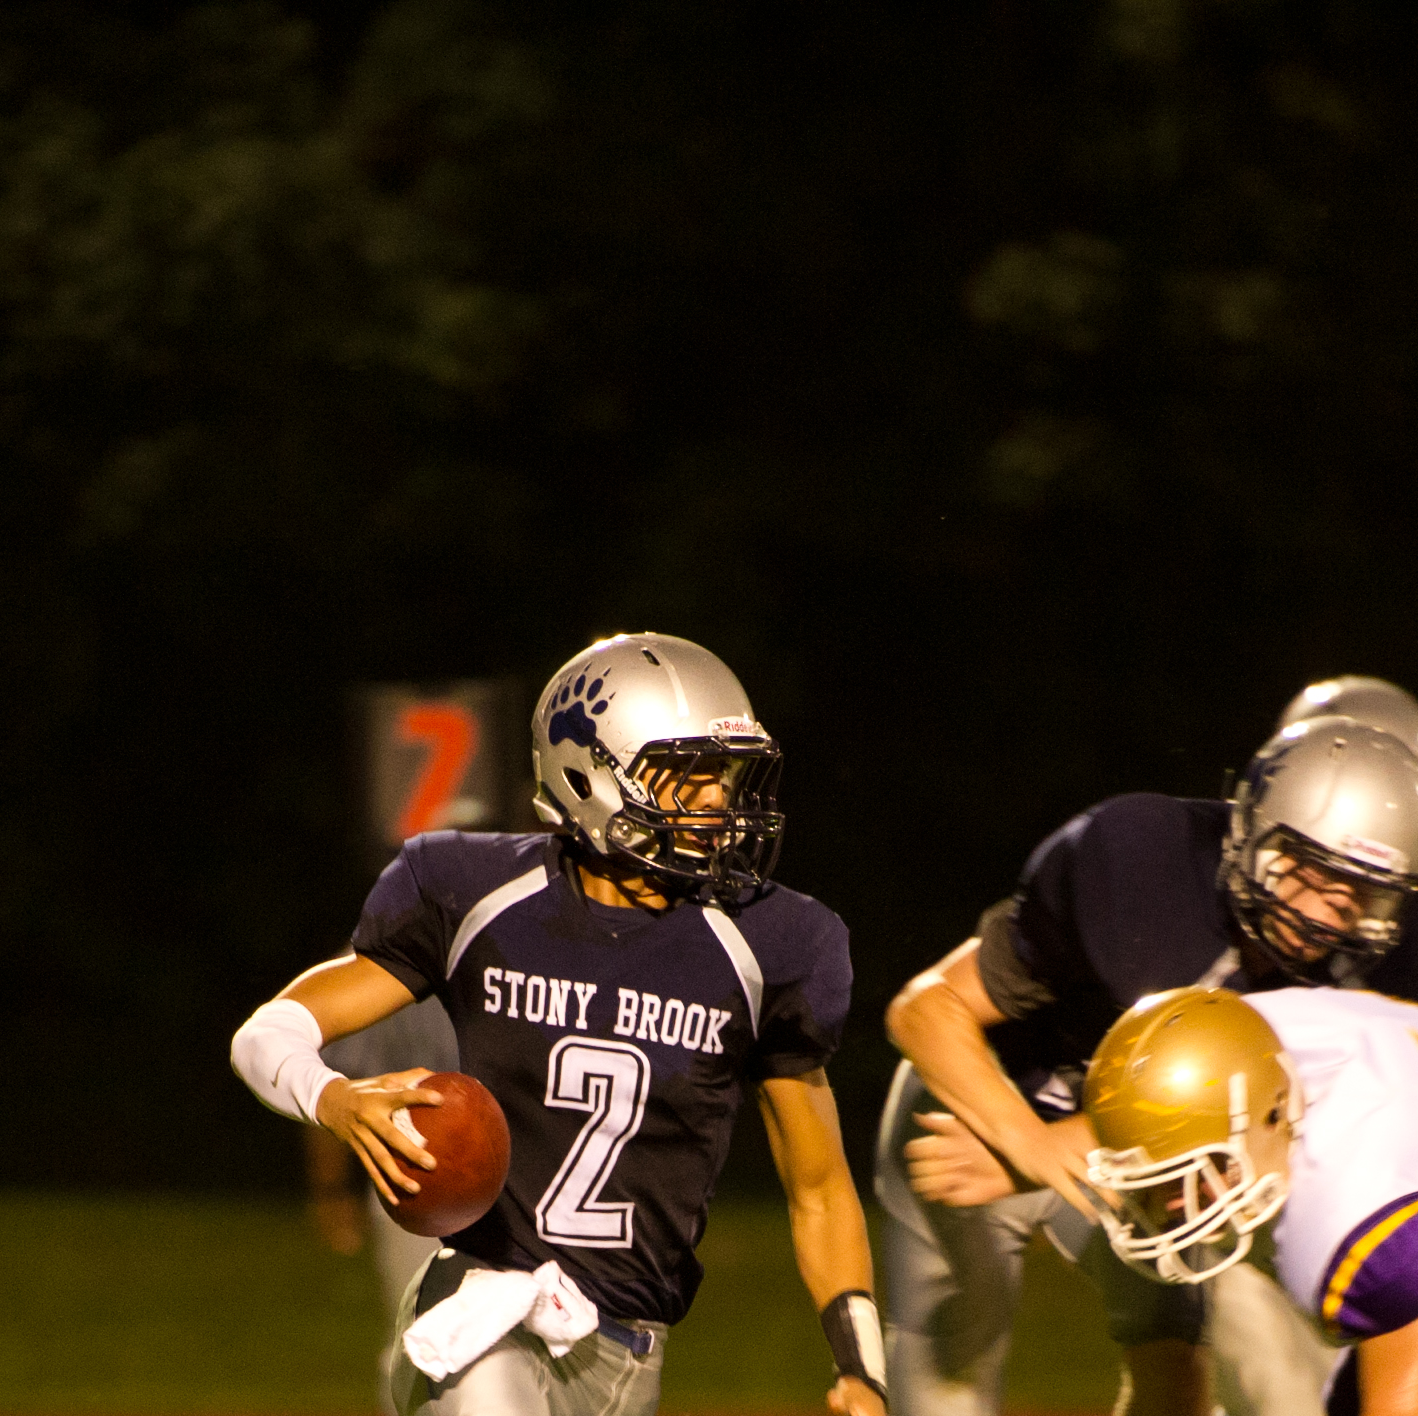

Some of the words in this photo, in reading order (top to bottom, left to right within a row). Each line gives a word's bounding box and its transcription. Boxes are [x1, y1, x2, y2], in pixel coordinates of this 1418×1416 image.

[614, 765, 647, 804] Riddell
[484, 966, 597, 1030] STONY
[613, 987, 732, 1054] BROOK
[535, 1035, 651, 1249] 2
